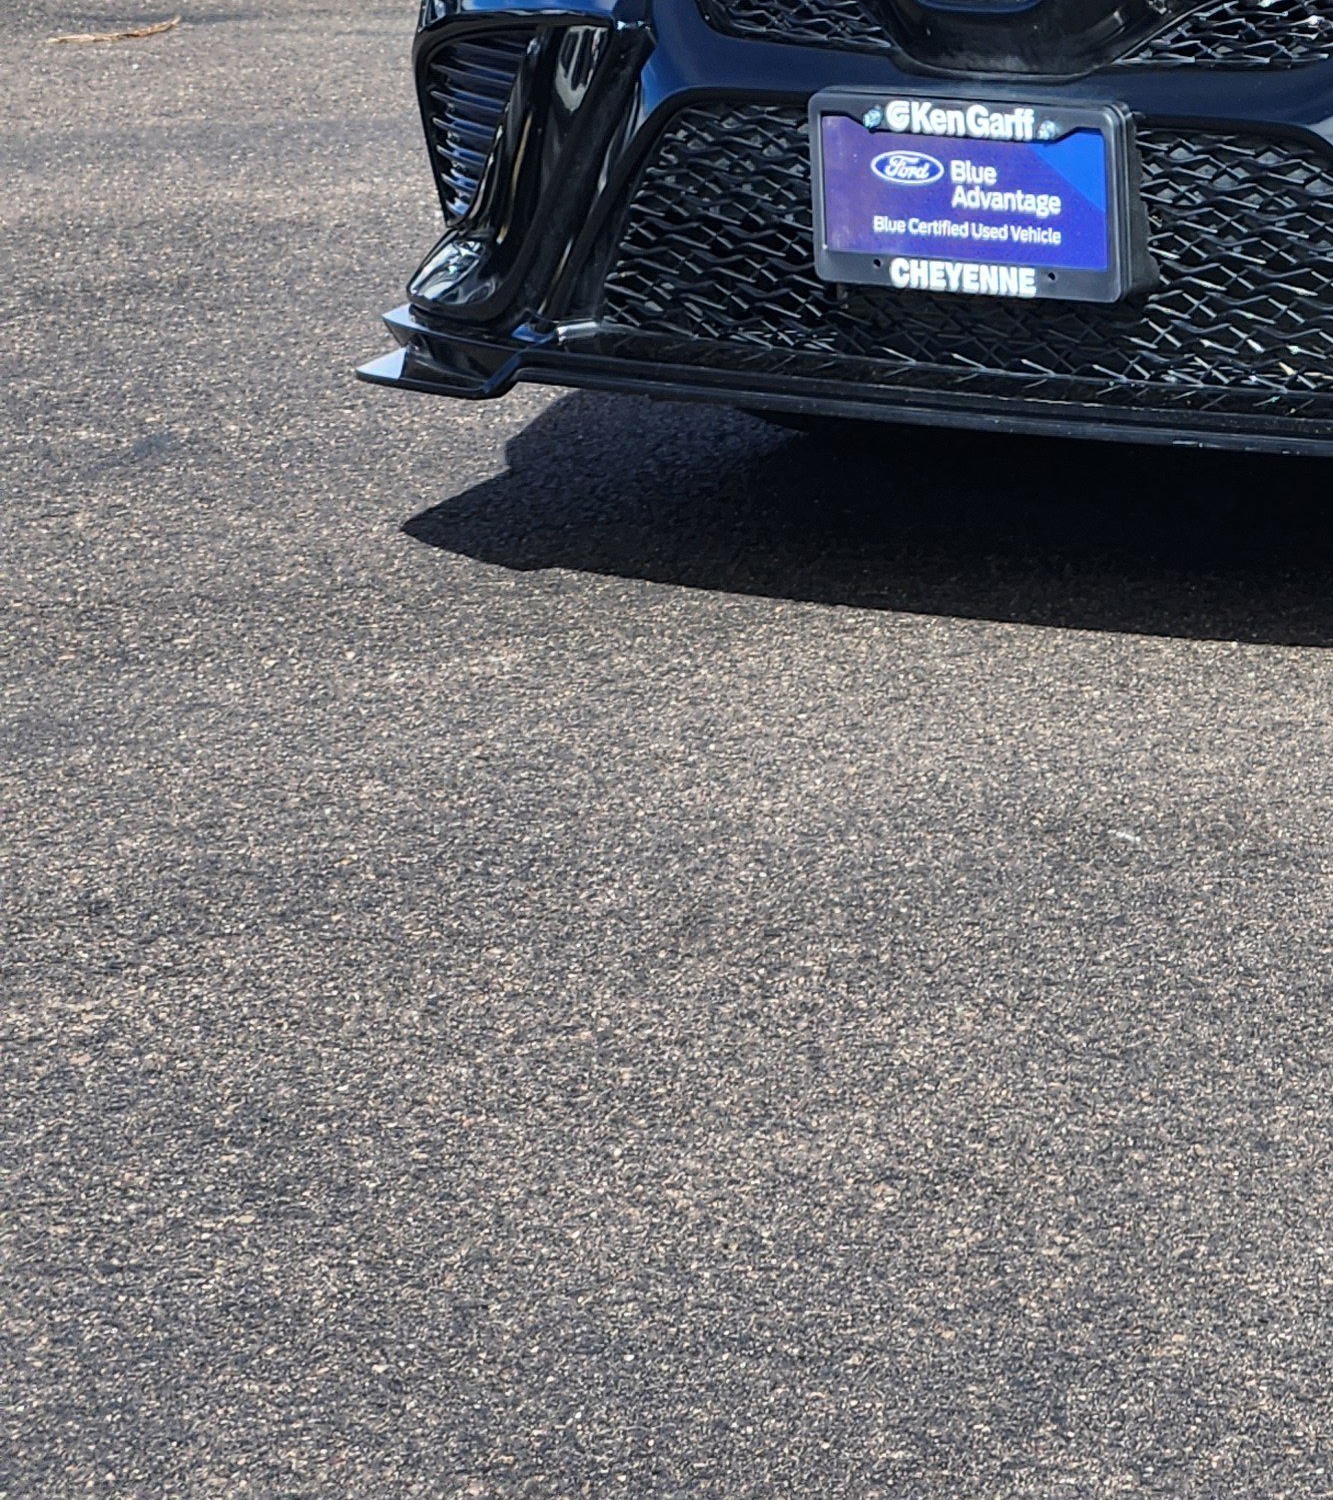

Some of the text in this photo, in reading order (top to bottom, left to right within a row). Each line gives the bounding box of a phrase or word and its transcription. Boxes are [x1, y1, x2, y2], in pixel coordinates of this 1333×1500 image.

[911, 101, 965, 137] Ken
[966, 104, 1035, 142] Garff
[885, 155, 930, 180] Ford
[950, 160, 997, 185] Blue
[951, 185, 1062, 219] Advantage
[873, 215, 1062, 244] Blue Certified Used Vehicle
[889, 257, 1037, 298] CHEYENNE
